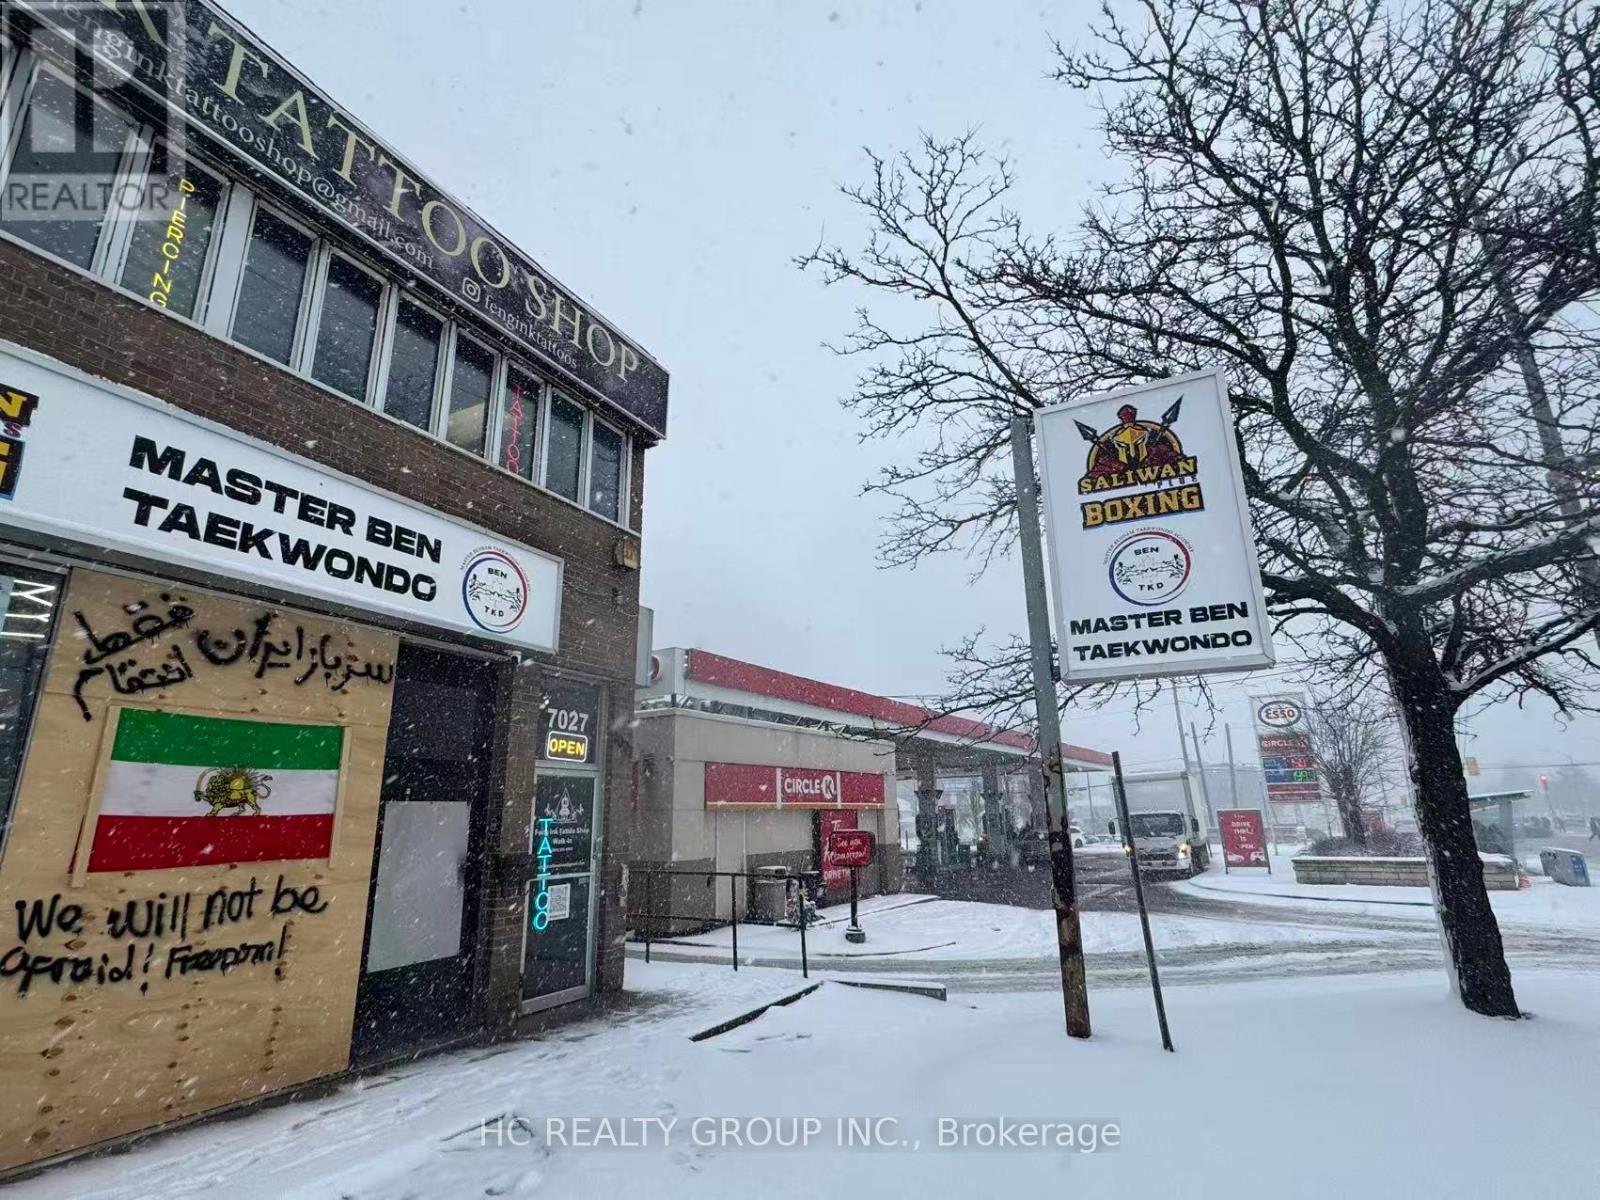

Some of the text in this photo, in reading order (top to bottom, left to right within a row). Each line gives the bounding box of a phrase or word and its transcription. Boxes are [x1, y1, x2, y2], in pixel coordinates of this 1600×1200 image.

[51, 0, 433, 269] enginktattooshop@gmail.com
[207, 22, 638, 382] TATTOO SHOP
[1080, 459, 1196, 492] SALIWAN
[129, 435, 442, 564] MASTER BEN
[1084, 486, 1202, 526] BOXING
[123, 487, 437, 602] TAEKWONDO
[1133, 546, 1160, 556] BEN
[487, 567, 508, 579] BEN
[1137, 582, 1165, 591] TKD
[484, 605, 505, 617] TKD
[1070, 601, 1249, 636] MASTER BEN
[1073, 630, 1253, 661] TAEKWONDO
[547, 707, 589, 732] 7027
[549, 738, 586, 756] OPEN
[784, 777, 821, 795] CIRCLE
[533, 818, 553, 930] TATTOO
[15, 893, 83, 943] We
[203, 876, 264, 931] not
[270, 874, 329, 919] be
